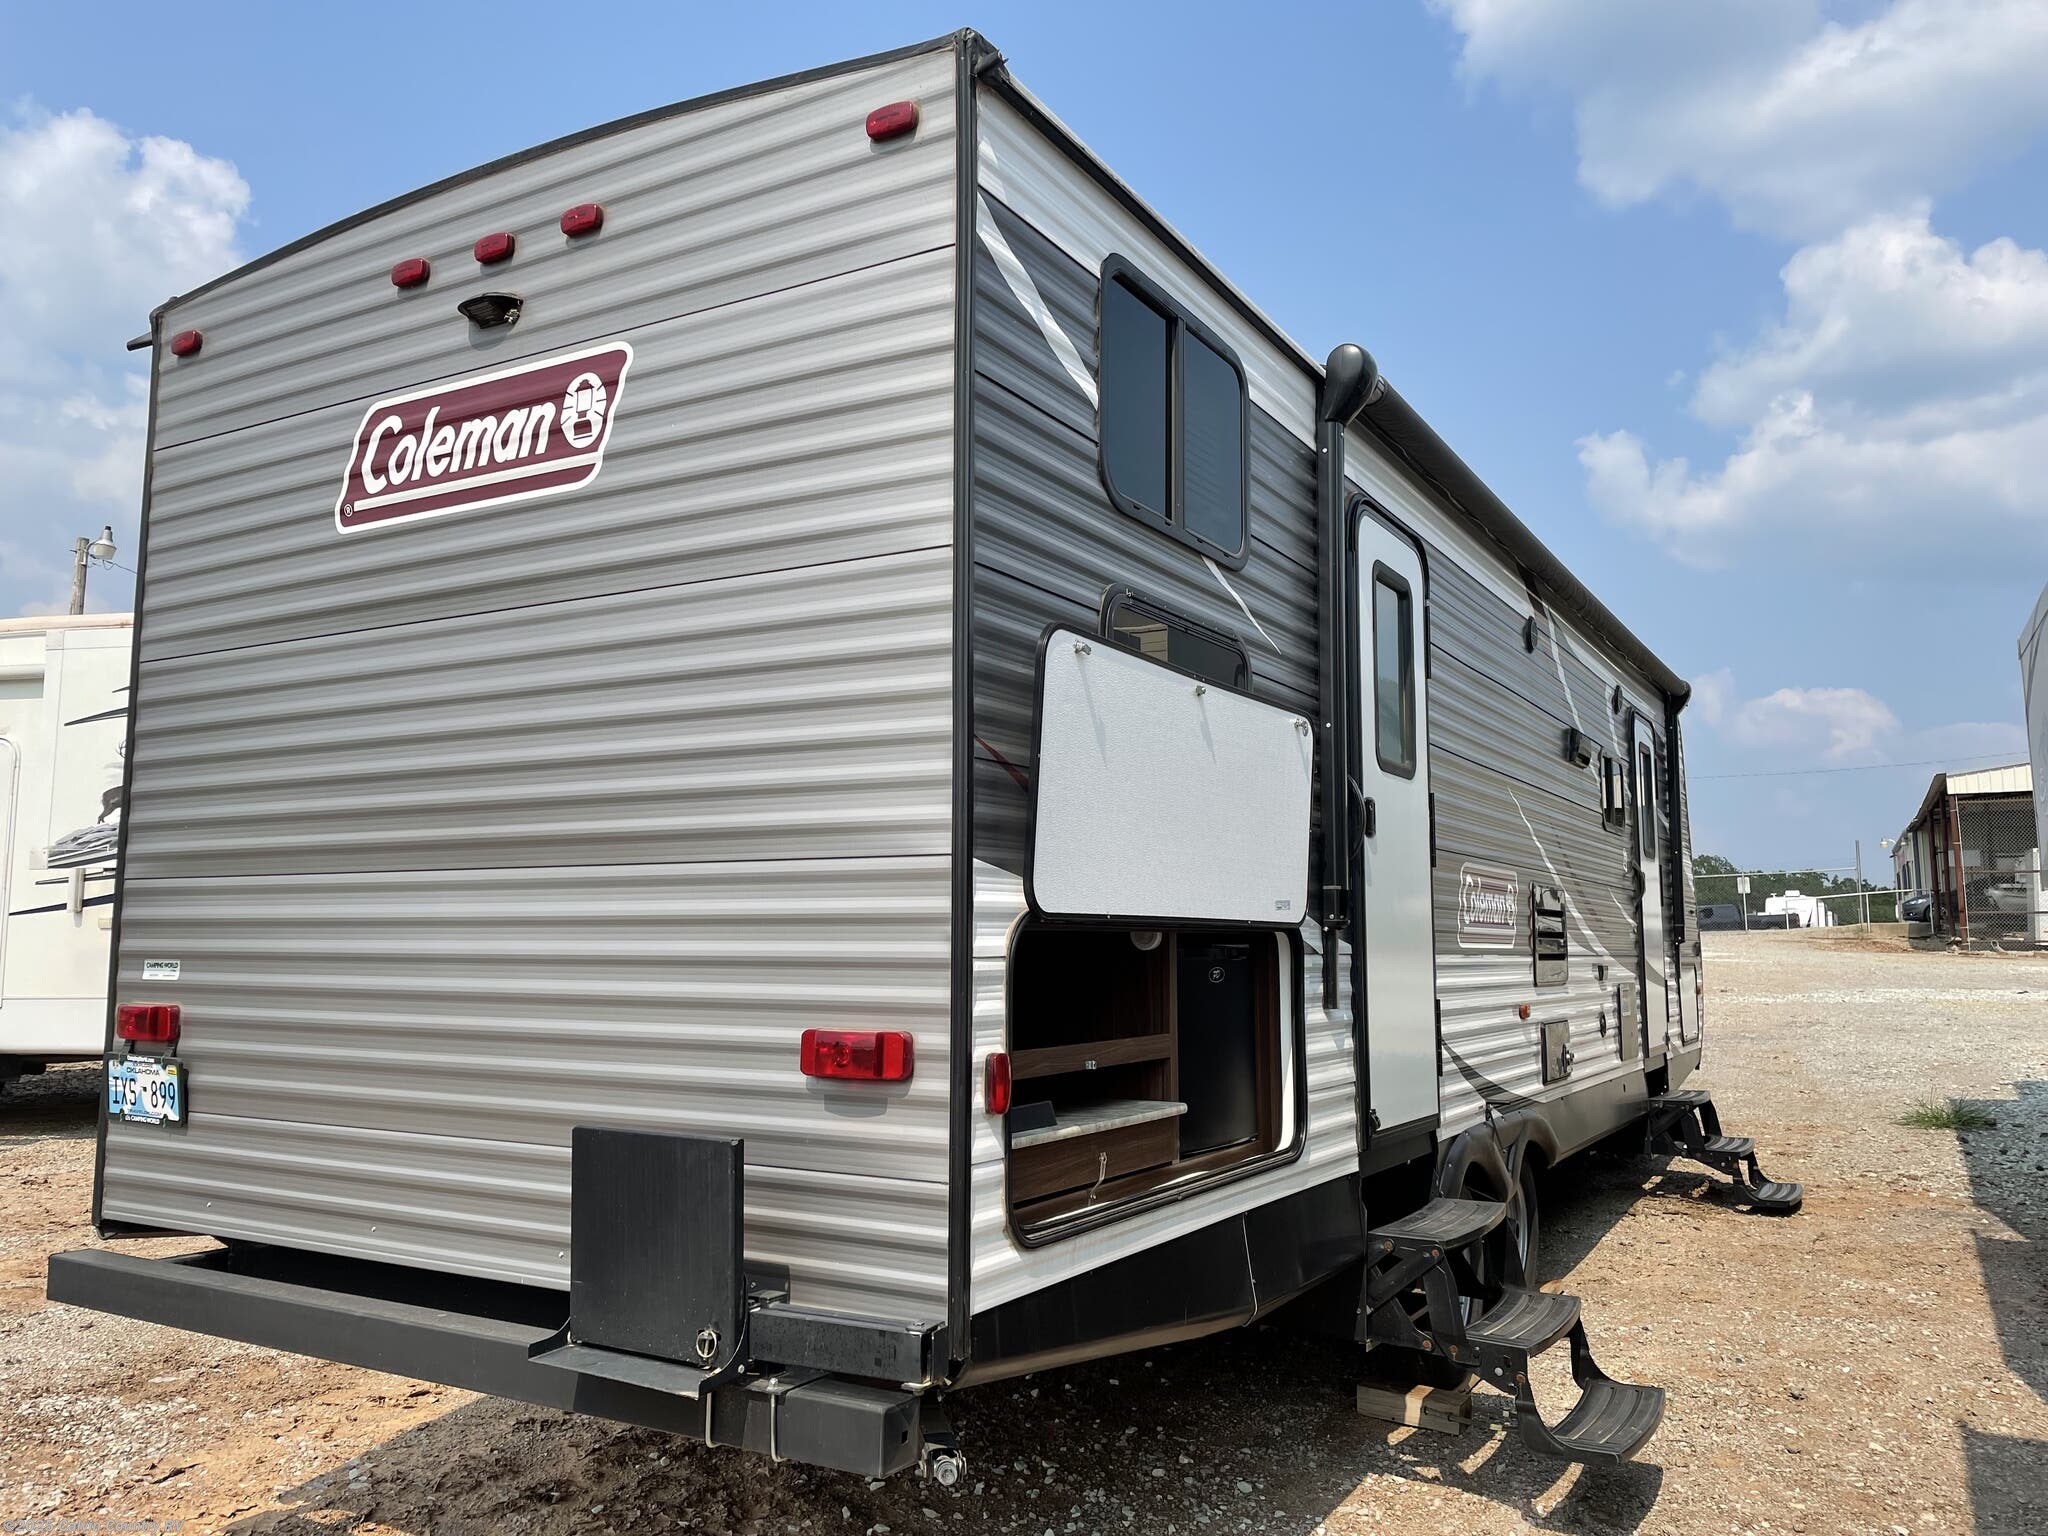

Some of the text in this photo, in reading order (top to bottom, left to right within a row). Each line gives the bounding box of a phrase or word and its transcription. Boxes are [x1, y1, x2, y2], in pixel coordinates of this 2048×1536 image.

[361, 401, 557, 494] Coleman
[1463, 874, 1506, 924] Coleman
[126, 1067, 160, 1076] OKLAHOMA
[150, 1080, 176, 1110] 899
